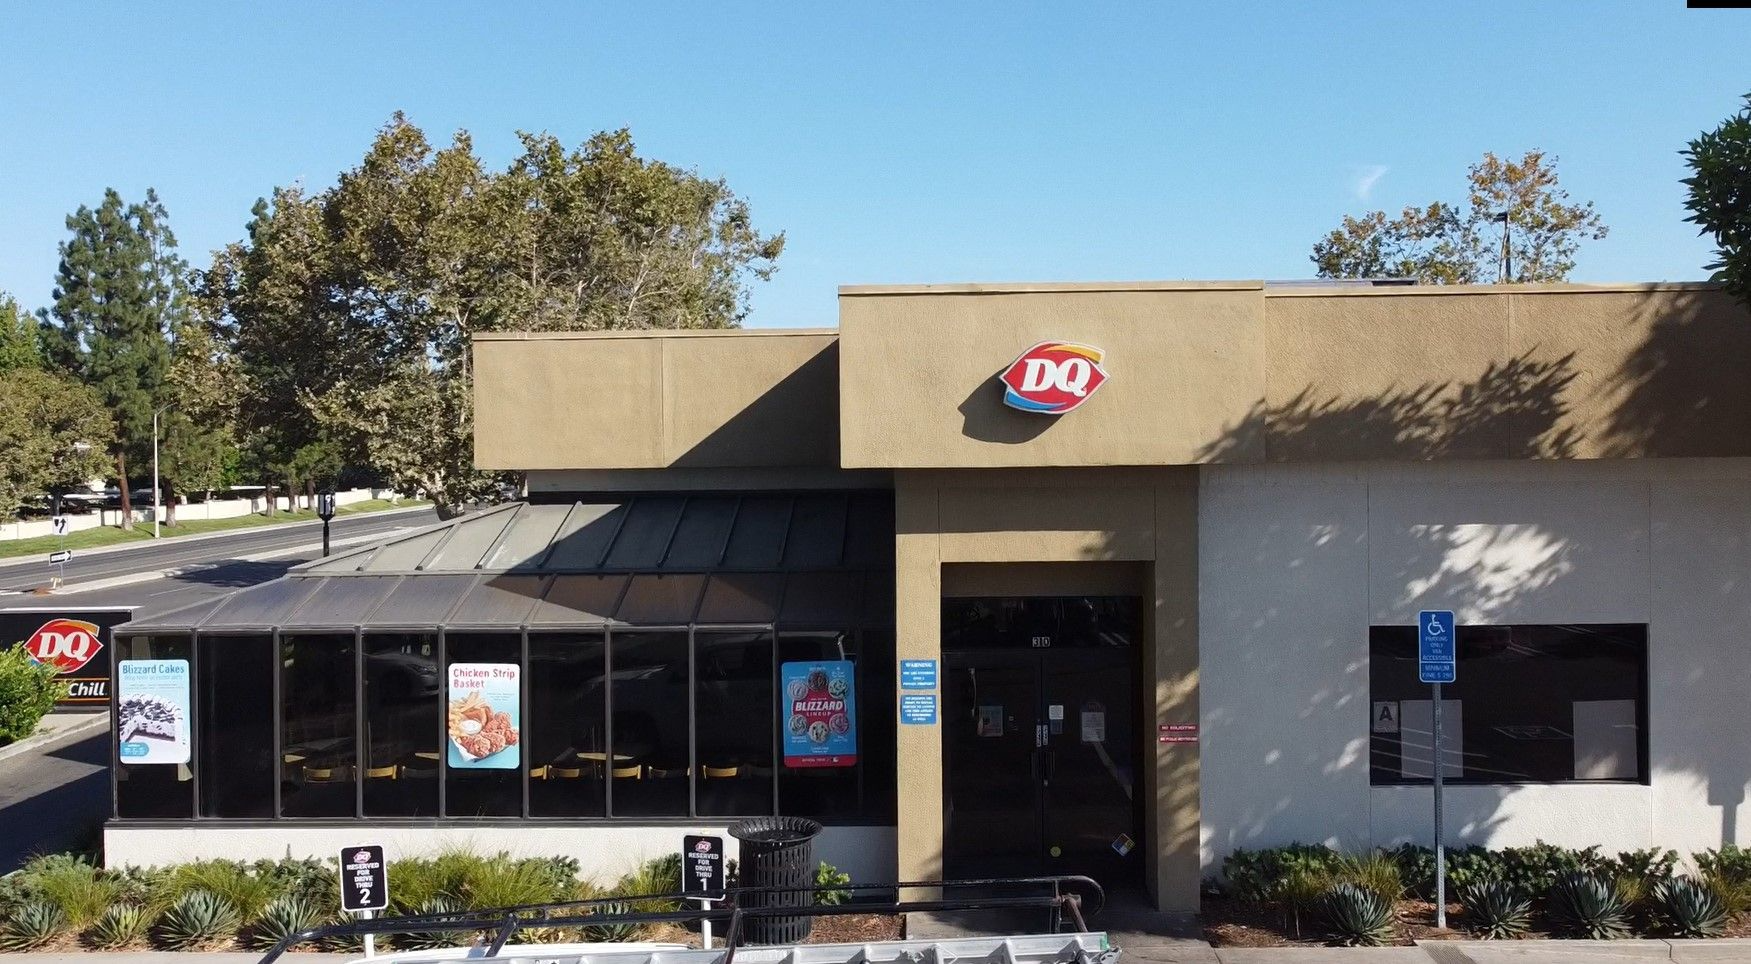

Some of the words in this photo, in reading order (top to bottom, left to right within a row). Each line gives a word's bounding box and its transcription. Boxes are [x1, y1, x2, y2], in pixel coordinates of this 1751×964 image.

[1020, 358, 1091, 397] DQ
[37, 631, 91, 662] DQ
[122, 664, 156, 674] Blizzard
[159, 664, 185, 674] Cakes
[453, 668, 490, 678] Chicken
[493, 668, 515, 680] Strip
[68, 682, 105, 696] Chill
[453, 679, 485, 688] Basket
[795, 701, 843, 711] BLIZZARD
[1379, 705, 1393, 721] A
[688, 852, 719, 860] RESERVED
[346, 862, 380, 870] RESERVED
[355, 881, 373, 889] THRU
[700, 878, 707, 891] 1
[359, 888, 371, 904] 2
